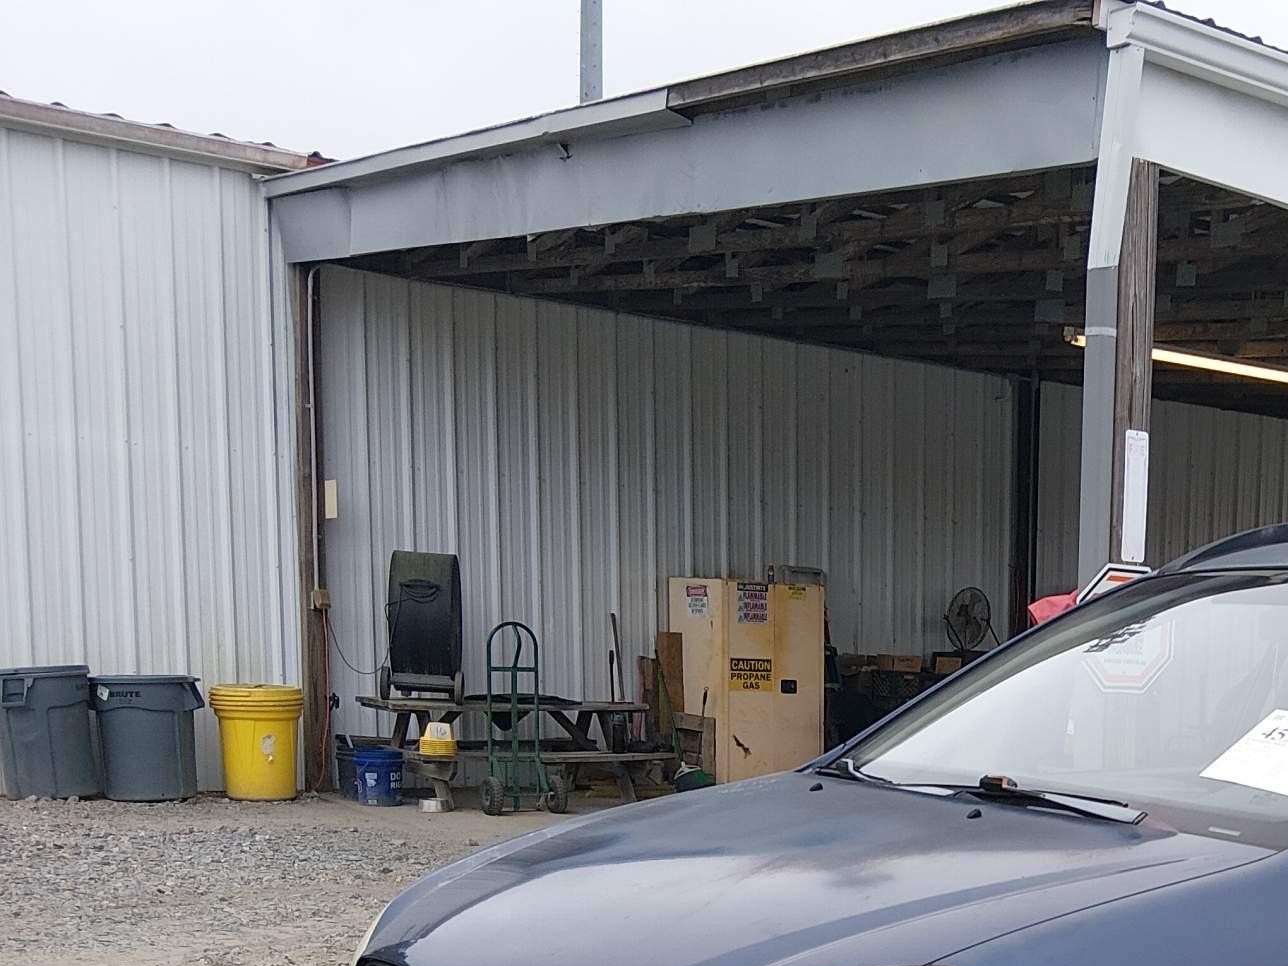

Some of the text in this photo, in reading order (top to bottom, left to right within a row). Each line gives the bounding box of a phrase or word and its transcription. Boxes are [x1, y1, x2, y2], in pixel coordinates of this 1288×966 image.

[731, 660, 771, 671] CAUTION
[731, 673, 772, 681] PROPANE
[743, 682, 760, 690] GAS
